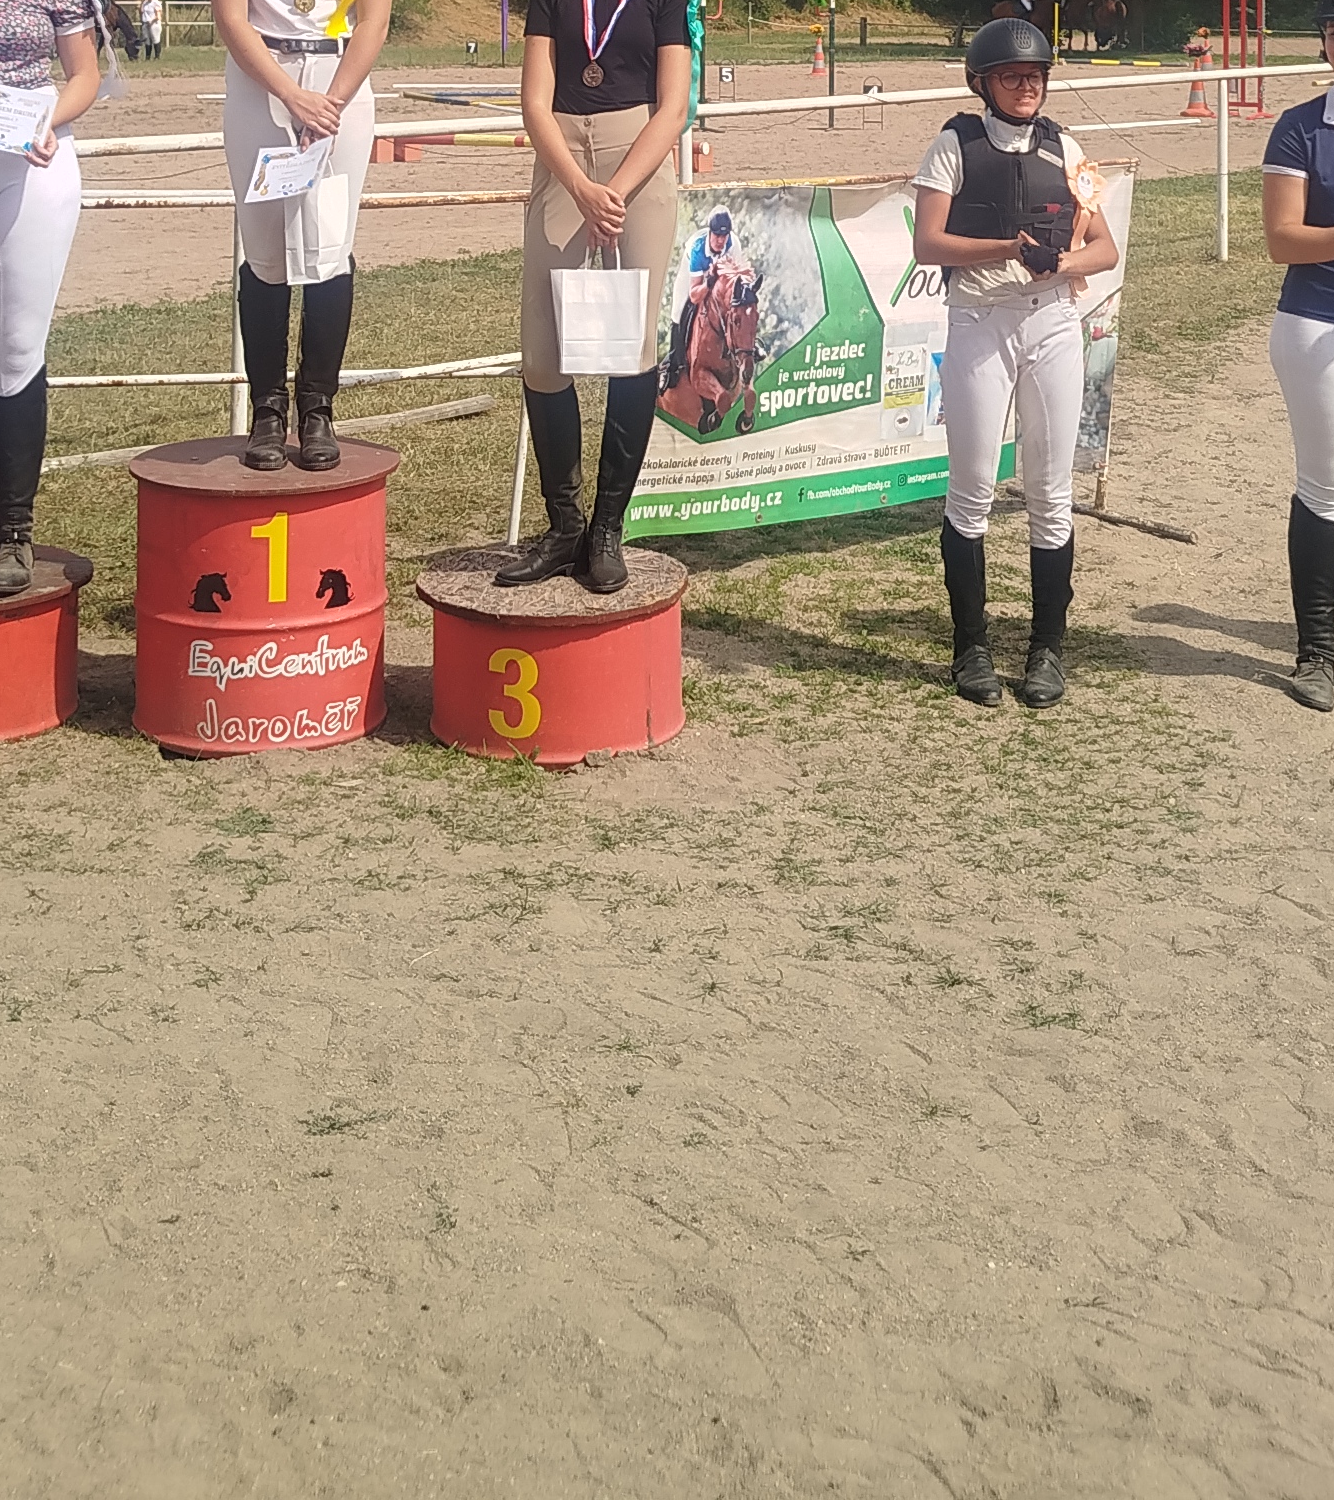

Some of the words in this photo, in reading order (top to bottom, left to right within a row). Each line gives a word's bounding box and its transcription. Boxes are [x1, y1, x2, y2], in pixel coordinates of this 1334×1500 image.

[468, 43, 475, 53] 7
[722, 68, 732, 82] 5
[805, 345, 812, 363] I
[815, 339, 866, 366] jezdec
[777, 369, 789, 386] je
[793, 363, 846, 380] vrcholový
[888, 375, 924, 390] CREAM
[759, 373, 873, 417] sportovec!
[635, 473, 683, 488] nergetické
[685, 471, 715, 485] nápoje
[725, 466, 753, 480] Sušené
[755, 464, 777, 478] plody
[778, 464, 783, 472] a
[784, 460, 807, 472] ovoce
[816, 453, 842, 467] Zdravá
[844, 452, 867, 463] strava
[874, 445, 898, 458] BUĎTE
[899, 444, 911, 454] FIT
[641, 456, 698, 470] zkokalorické
[699, 455, 732, 466] dezerty
[742, 448, 775, 461] Proteiny
[784, 443, 817, 456] Kuskusy
[630, 491, 783, 521] www.yourbody.cz
[250, 512, 288, 603] 1
[188, 634, 368, 692] EquiCentrum
[488, 648, 541, 739] 3
